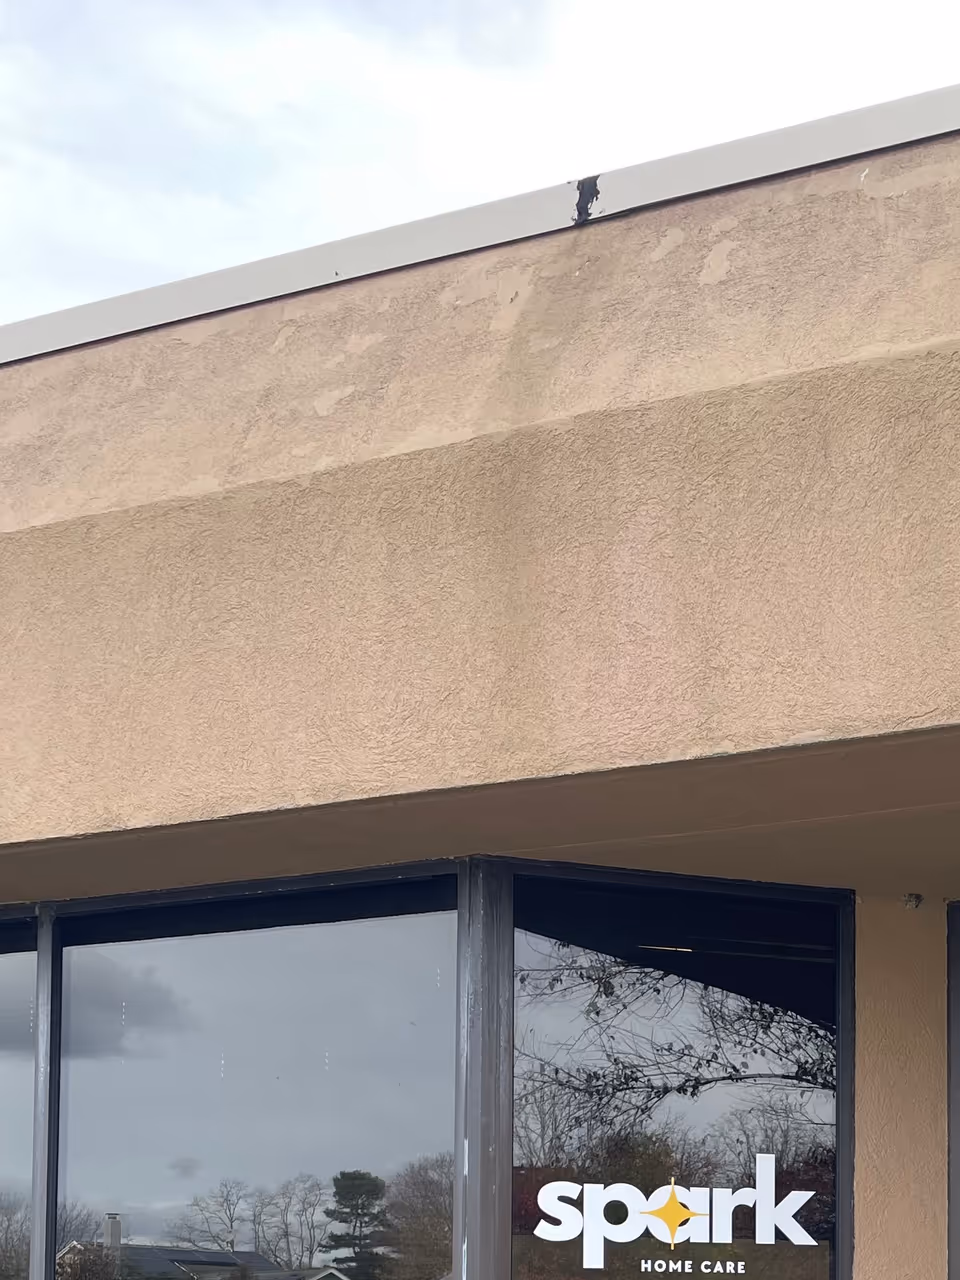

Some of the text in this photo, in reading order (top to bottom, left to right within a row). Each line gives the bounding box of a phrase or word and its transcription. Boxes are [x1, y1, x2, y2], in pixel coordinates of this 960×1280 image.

[533, 1154, 819, 1269] spark
[640, 1259, 746, 1274] HOME CARE
